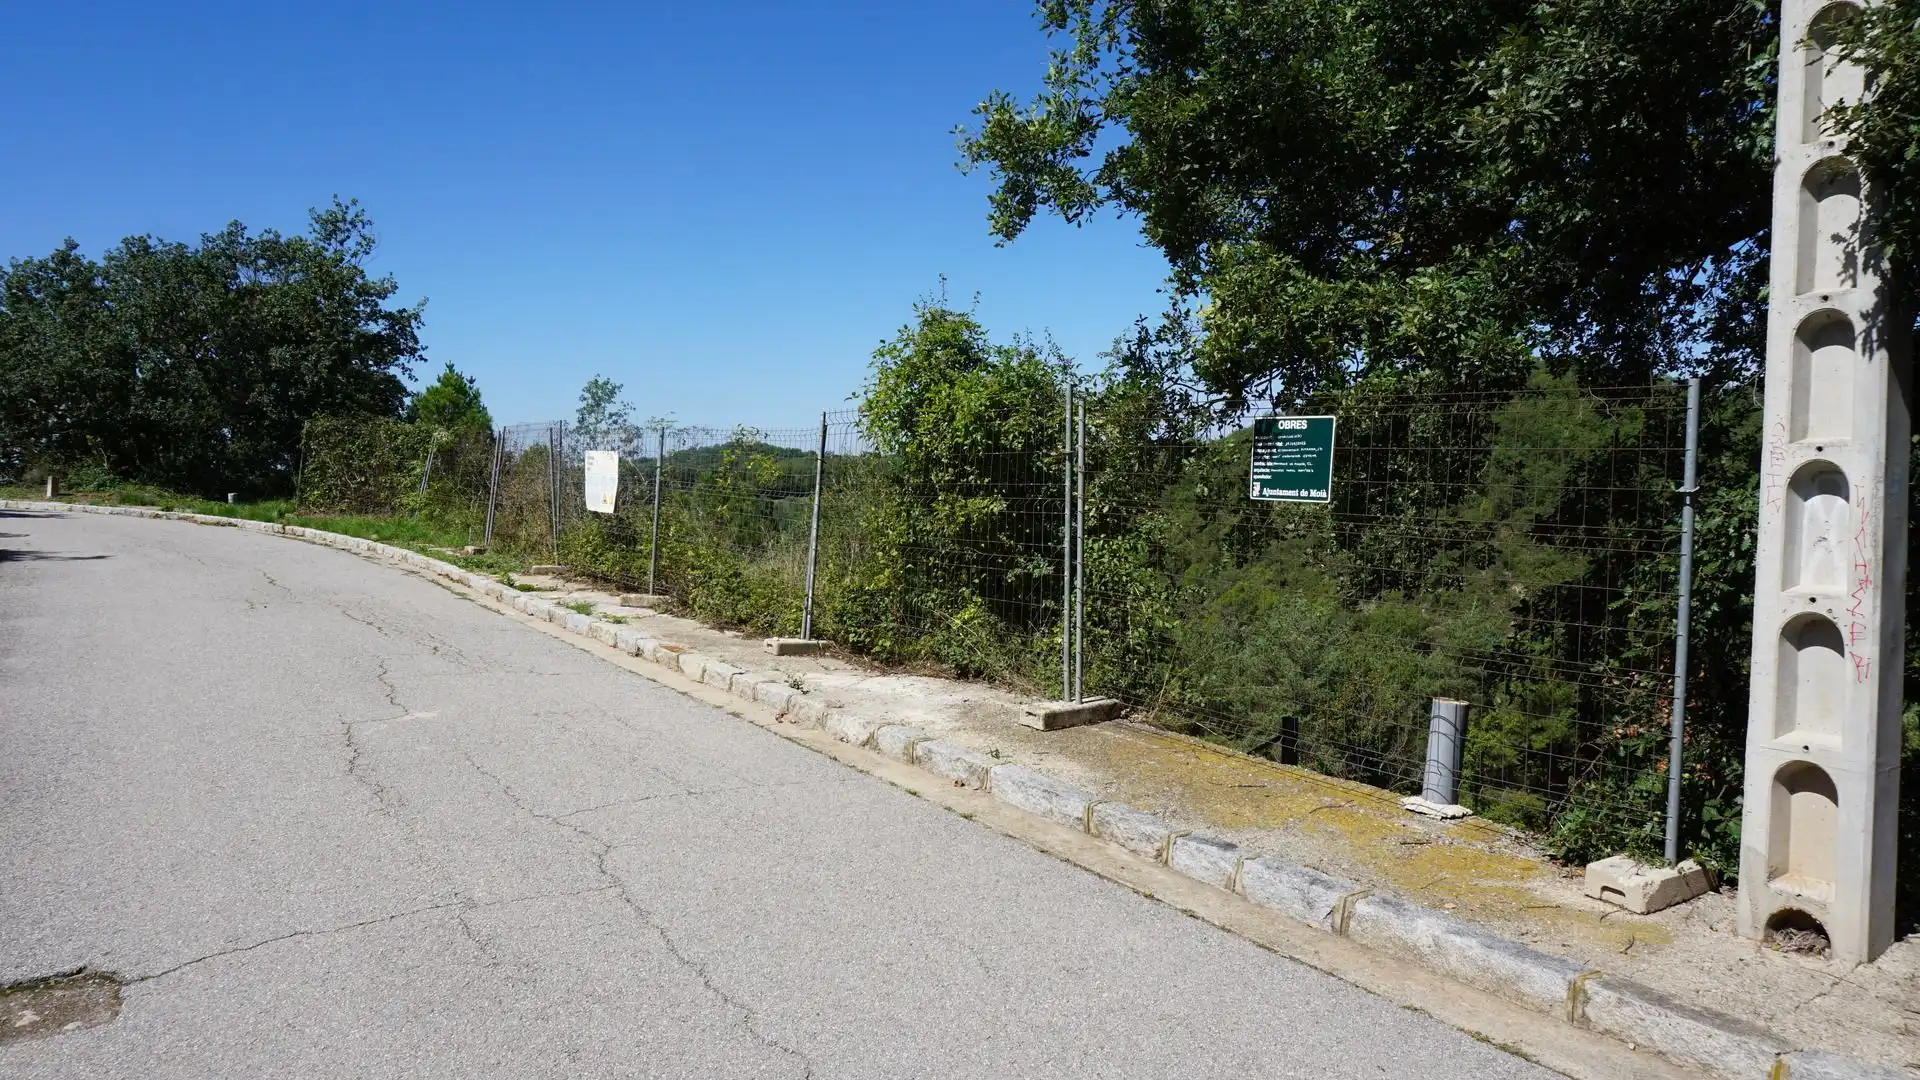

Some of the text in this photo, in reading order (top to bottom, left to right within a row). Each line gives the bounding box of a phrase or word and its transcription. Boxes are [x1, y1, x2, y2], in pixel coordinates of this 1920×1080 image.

[1278, 420, 1308, 430] OBRES
[1262, 487, 1299, 498] Ajuntament
[1300, 489, 1308, 497] de
